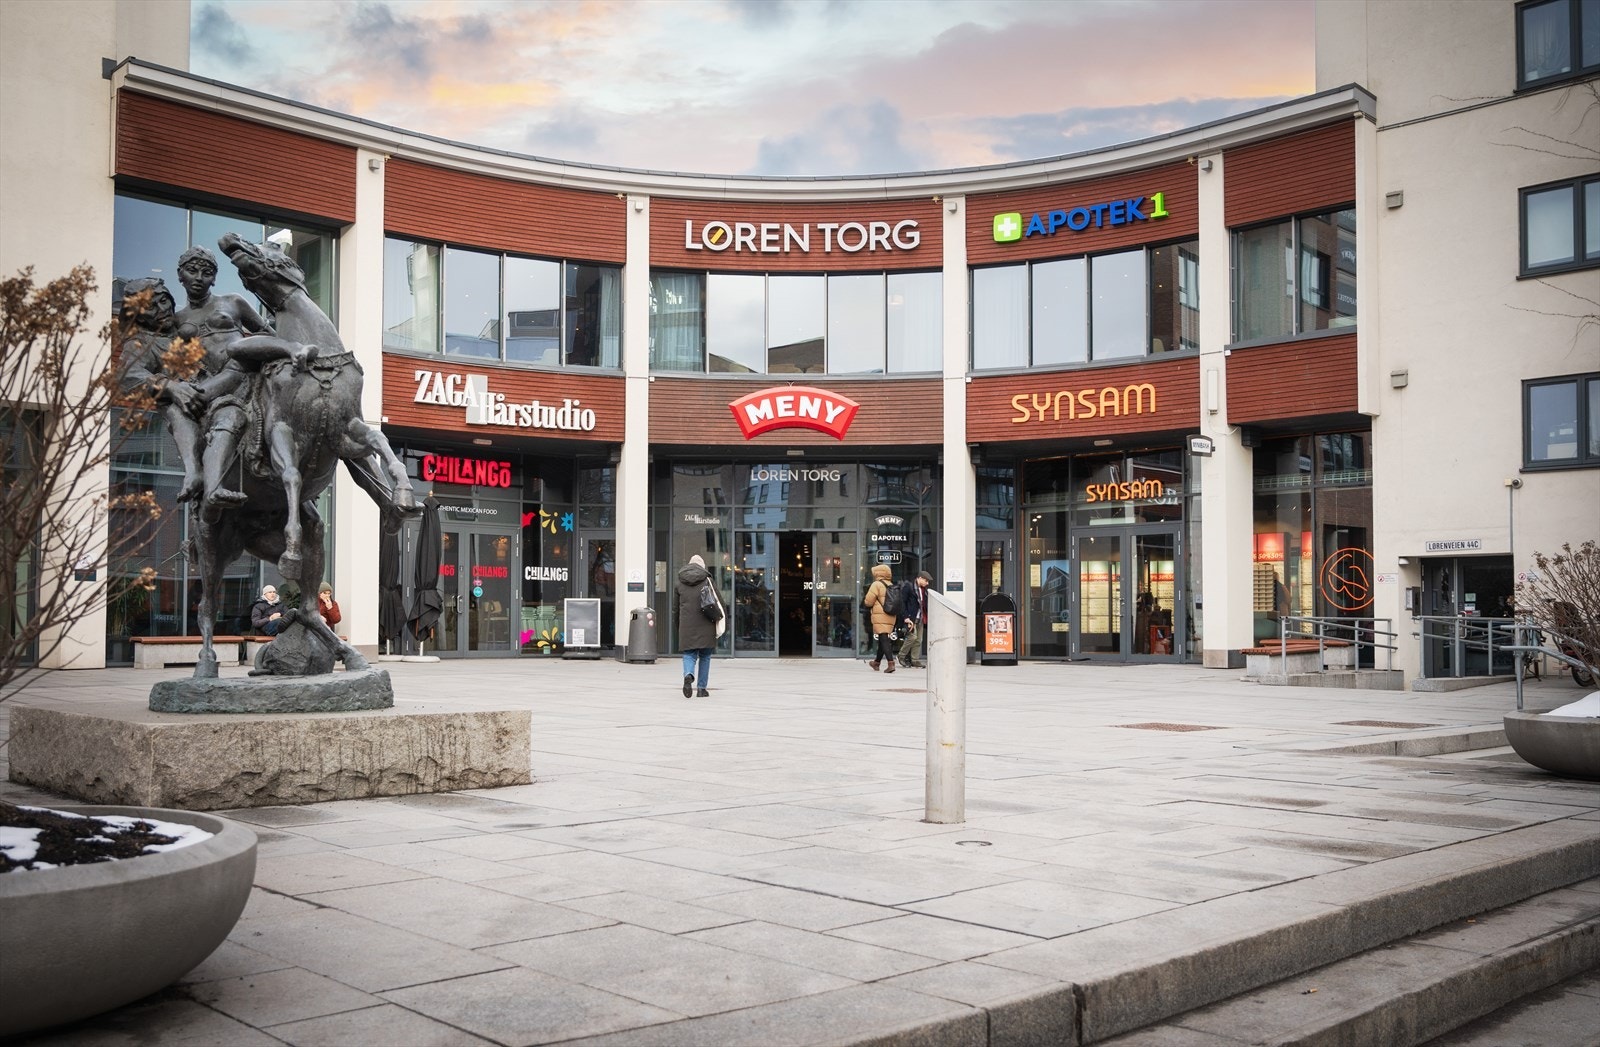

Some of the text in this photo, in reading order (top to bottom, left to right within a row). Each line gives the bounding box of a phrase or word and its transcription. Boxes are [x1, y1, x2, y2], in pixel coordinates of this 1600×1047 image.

[1025, 192, 1169, 237] APOTEK 1
[817, 219, 921, 252] TORG
[414, 370, 597, 432] ZAGA Hårstudio
[744, 395, 847, 426] MENY
[1011, 383, 1156, 424] SYNSAM
[801, 469, 841, 482] TORG
[1086, 479, 1163, 503] SYNSAM
[878, 516, 901, 525] MENY
[879, 553, 899, 561] norli
[1466, 540, 1479, 548] 44C
